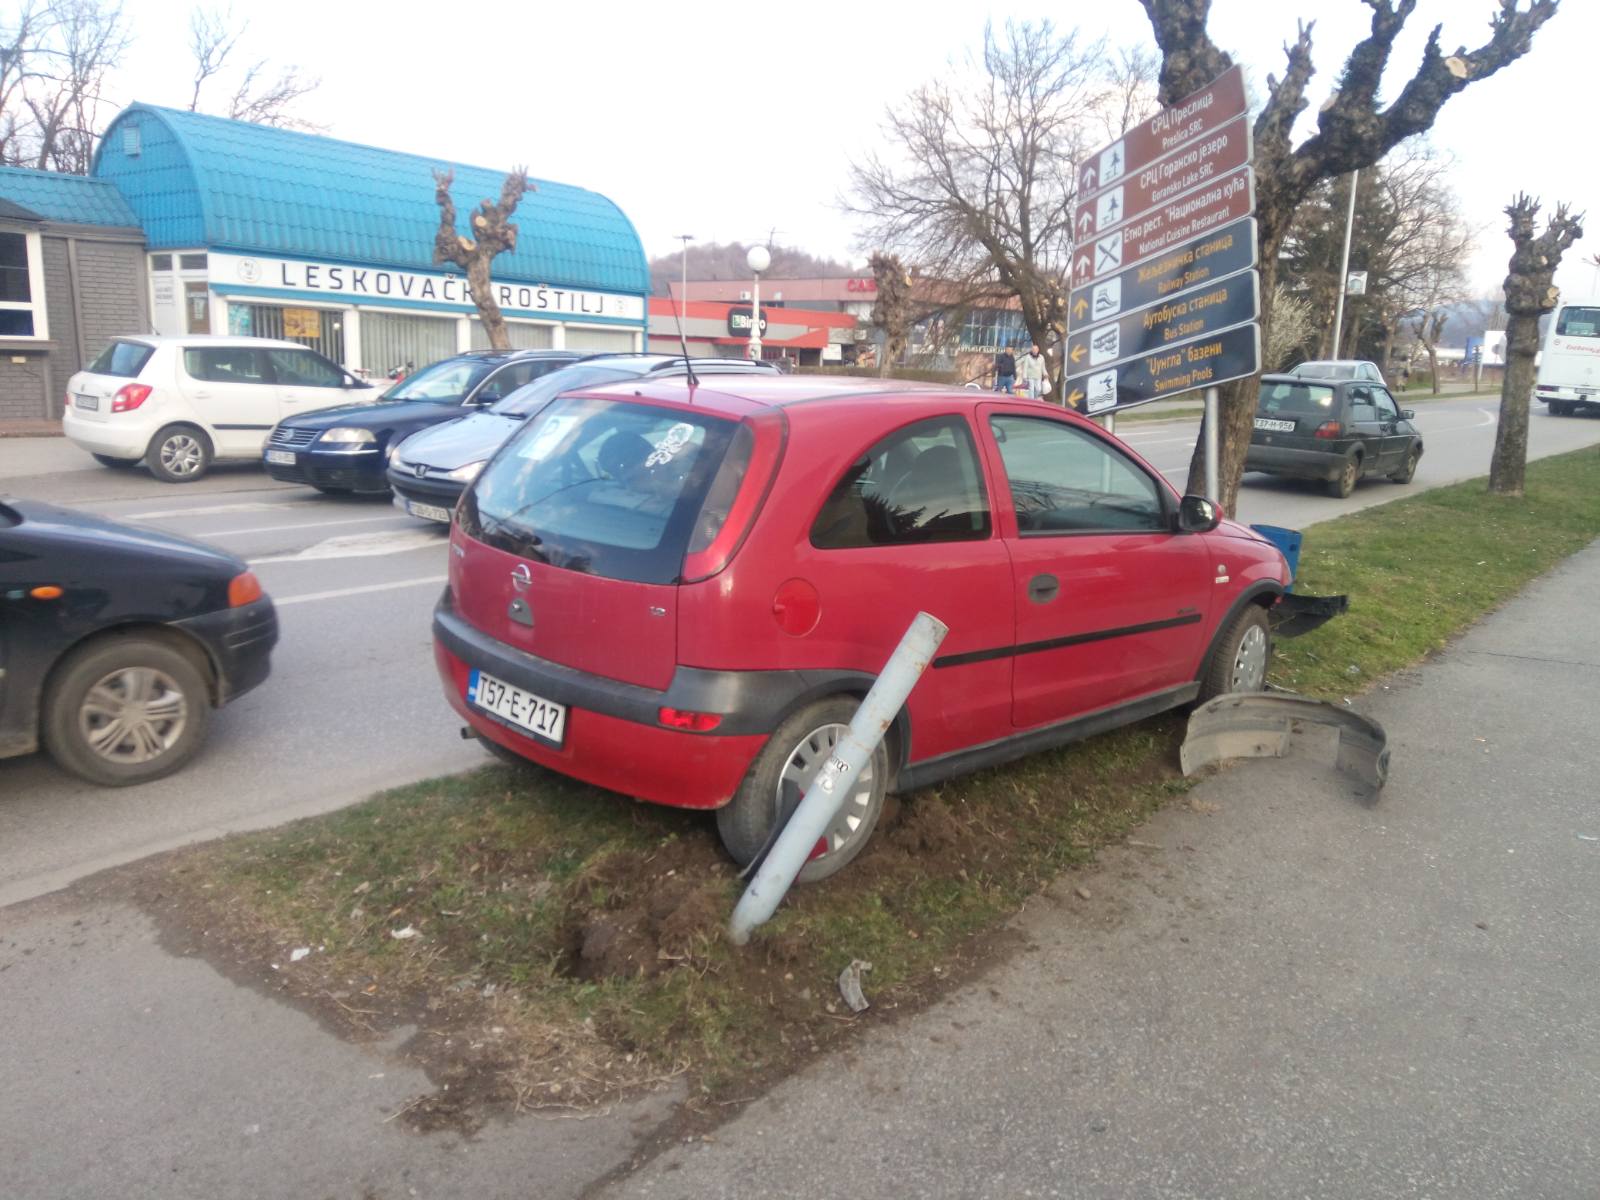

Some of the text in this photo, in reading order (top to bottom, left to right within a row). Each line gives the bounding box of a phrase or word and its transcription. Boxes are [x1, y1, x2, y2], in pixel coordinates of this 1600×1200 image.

[1151, 92, 1213, 135] СРЦ Преслица
[1162, 118, 1203, 150] Preslica SRC
[1140, 135, 1228, 189] СРЦ Горанско језеро
[1152, 162, 1214, 202] Goransko Lake SRC
[1124, 226, 1142, 243] Етно
[1139, 206, 1230, 254] National Cuisine Restaurant
[281, 261, 603, 314] LESKOVAČK ROŠTILJ
[847, 278, 878, 292] CAS
[741, 315, 766, 329] Bino
[1143, 288, 1228, 330] Аутобуска станица
[1164, 319, 1205, 341] Bus Station
[1187, 342, 1222, 363] базени
[1154, 366, 1213, 392] Swimming Pools
[479, 675, 560, 735] T57-E-717
